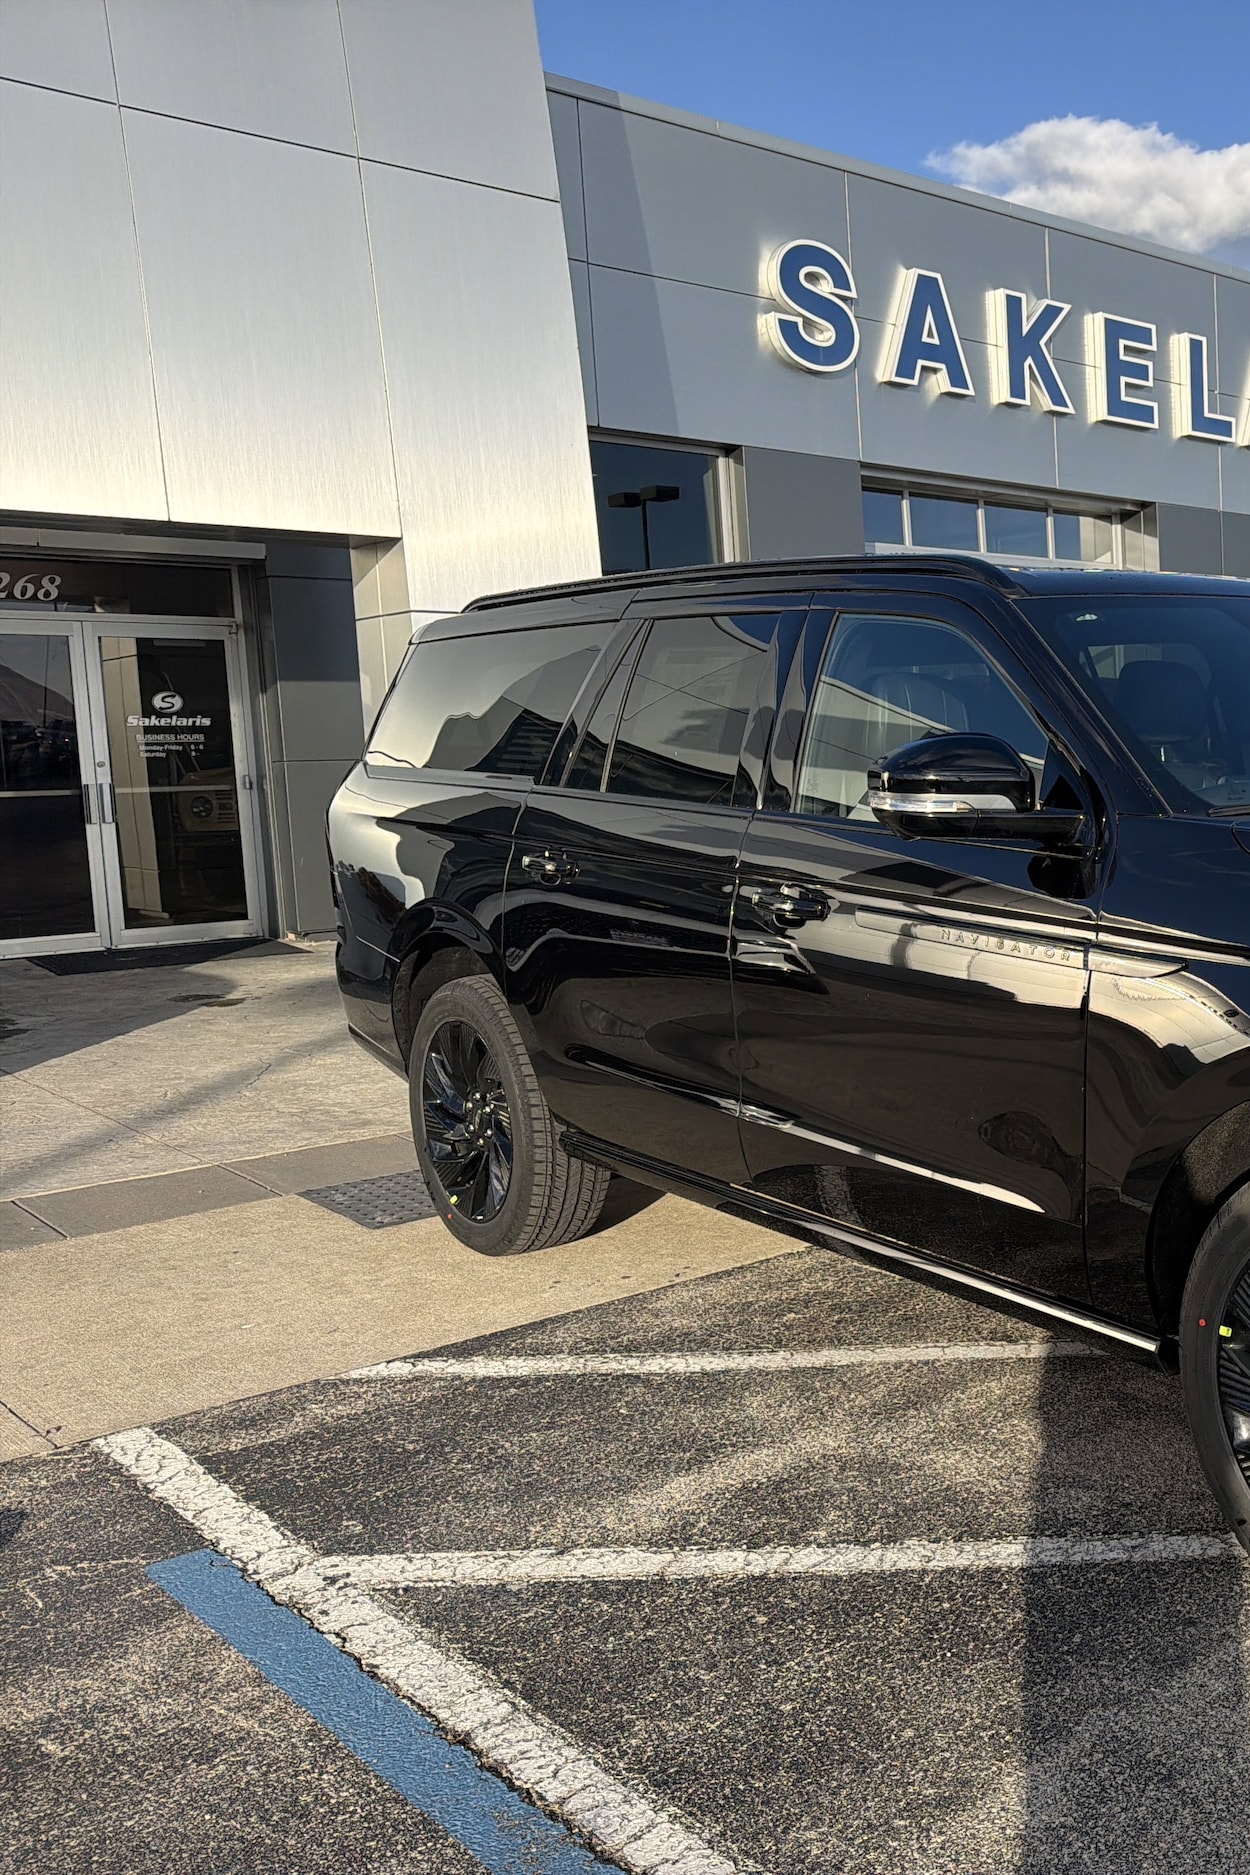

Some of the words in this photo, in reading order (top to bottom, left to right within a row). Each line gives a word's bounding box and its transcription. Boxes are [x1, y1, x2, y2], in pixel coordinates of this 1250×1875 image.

[127, 714, 212, 727] Sakelaris
[136, 733, 176, 741] BUSINESS
[940, 928, 1071, 962] NAVIGATOR
